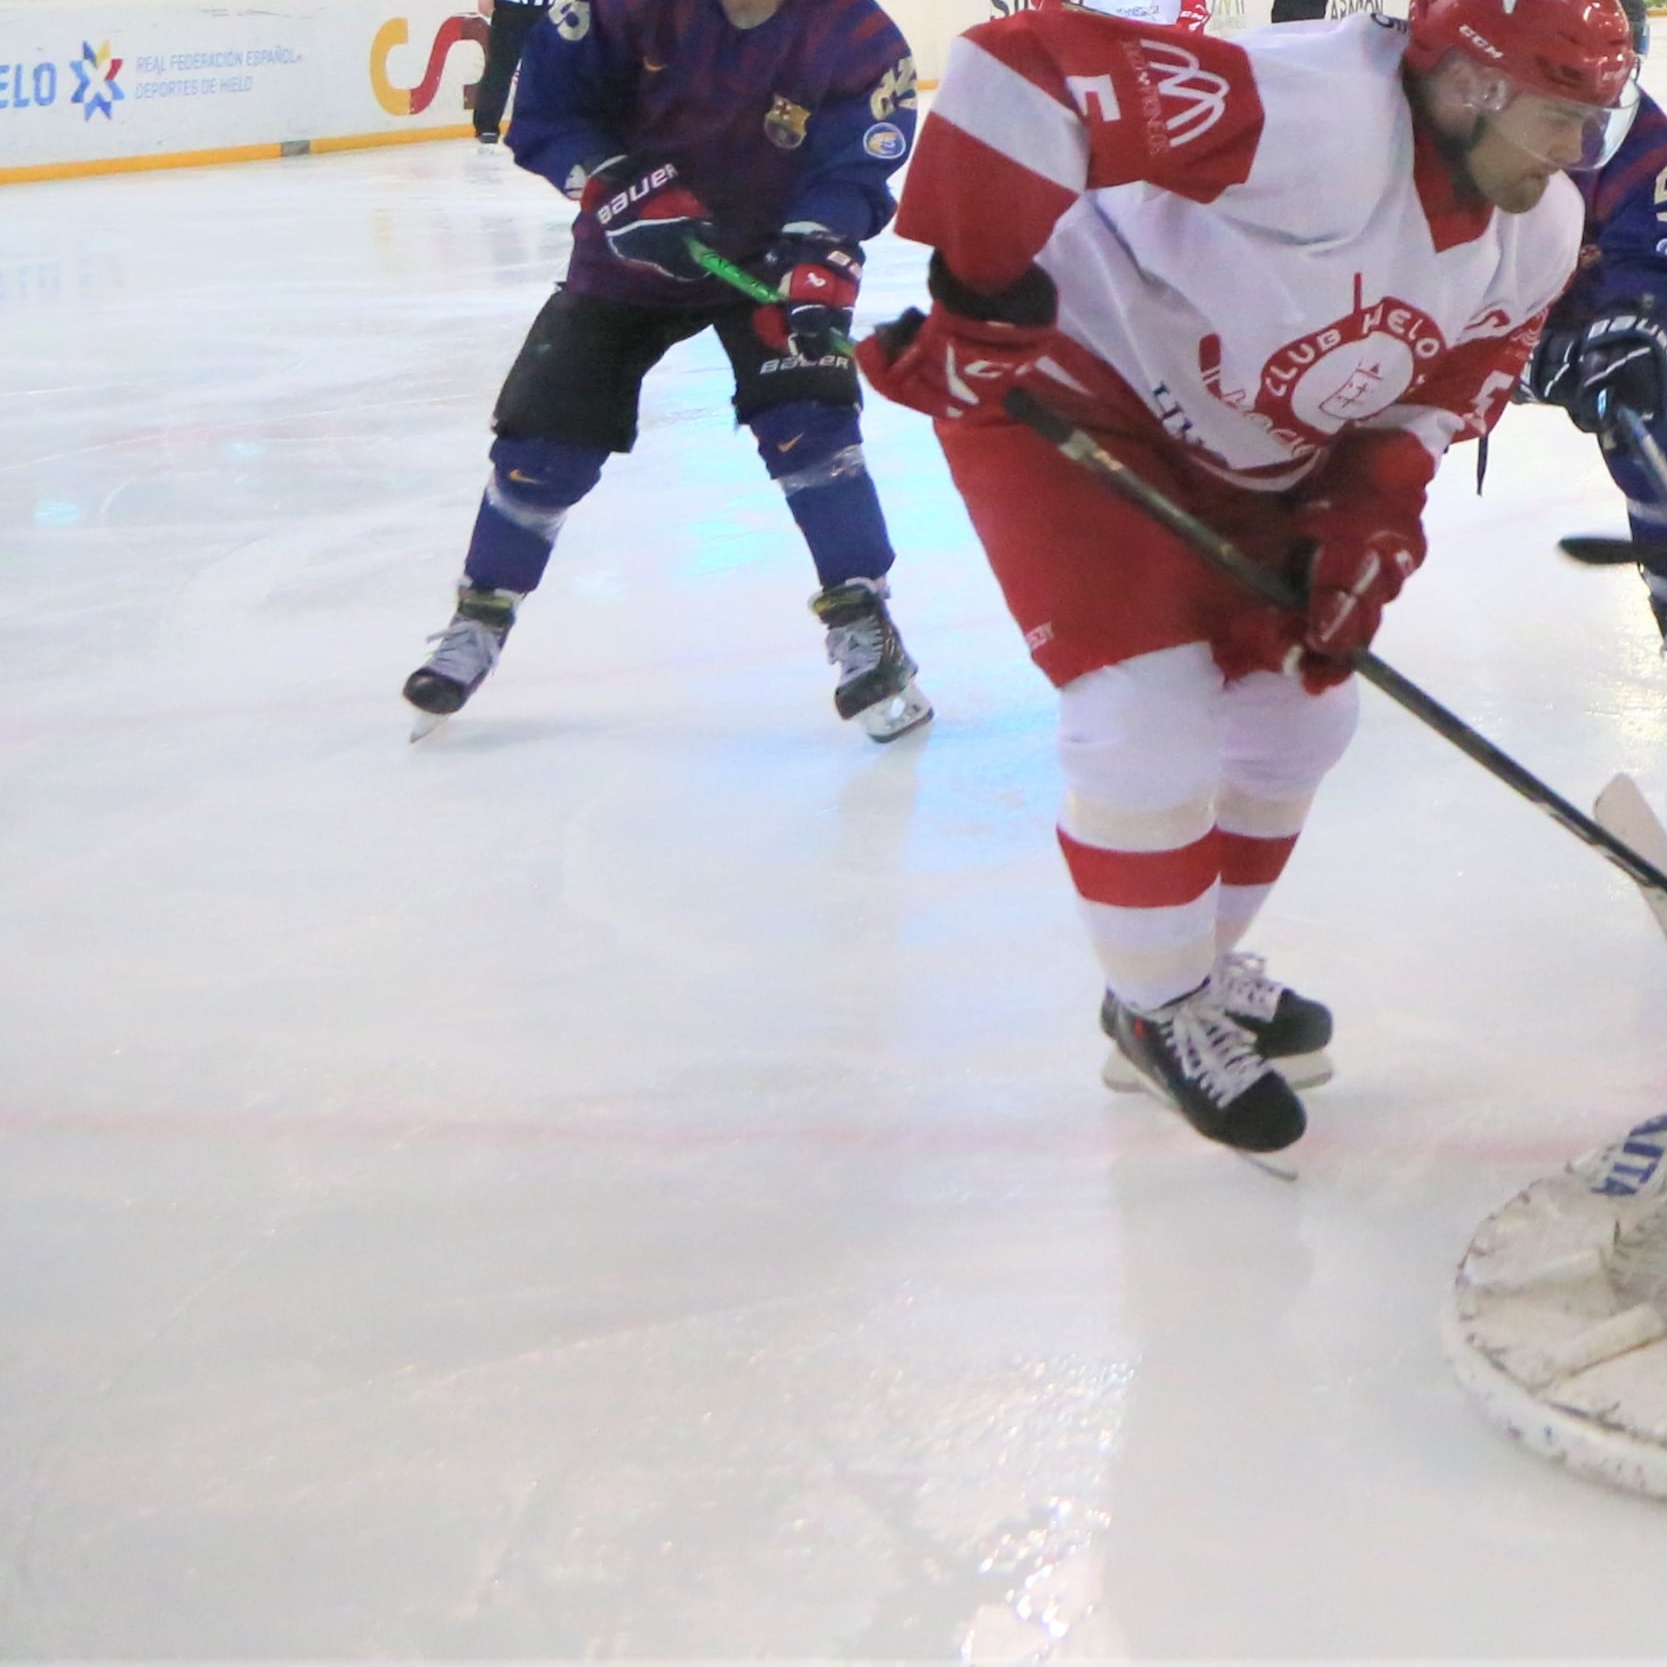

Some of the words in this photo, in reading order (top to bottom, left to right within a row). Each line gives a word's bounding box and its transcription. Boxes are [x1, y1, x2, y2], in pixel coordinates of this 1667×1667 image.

[1458, 24, 1504, 60] CCM
[135, 56, 167, 75] REAL
[170, 47, 243, 71] FEDERACIÓN
[135, 80, 198, 100] DEPORTES
[201, 78, 216, 95] DE
[219, 75, 254, 94] HIELO
[1265, 328, 1342, 398] CLUB
